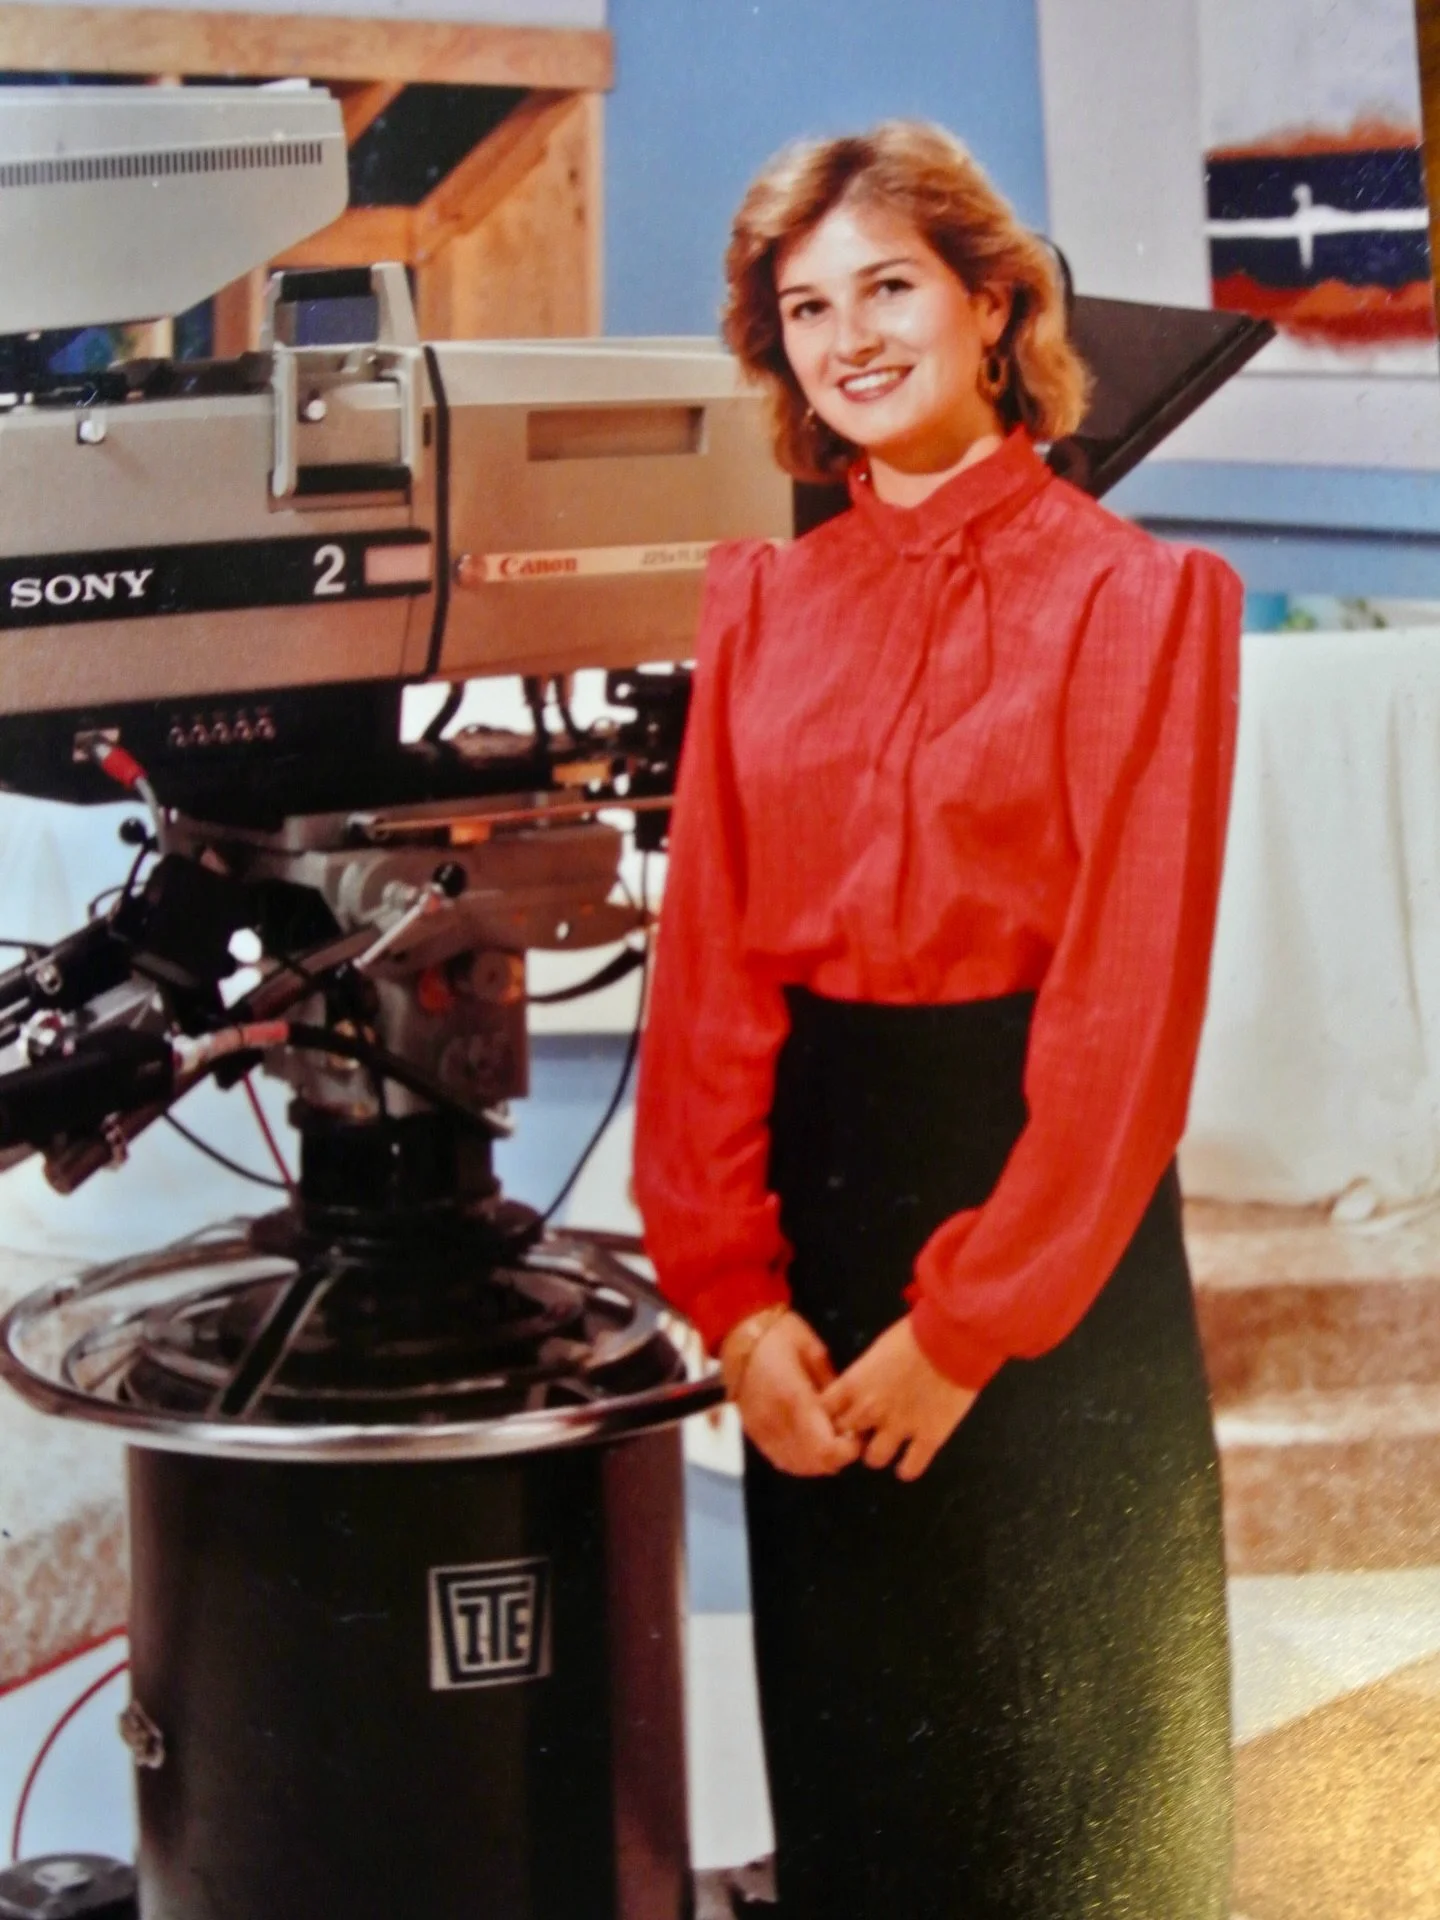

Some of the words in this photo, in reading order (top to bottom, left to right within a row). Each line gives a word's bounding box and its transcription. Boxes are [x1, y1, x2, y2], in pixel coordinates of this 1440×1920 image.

[313, 543, 346, 596] 2
[499, 556, 577, 577] Canon
[10, 568, 154, 607] SONY
